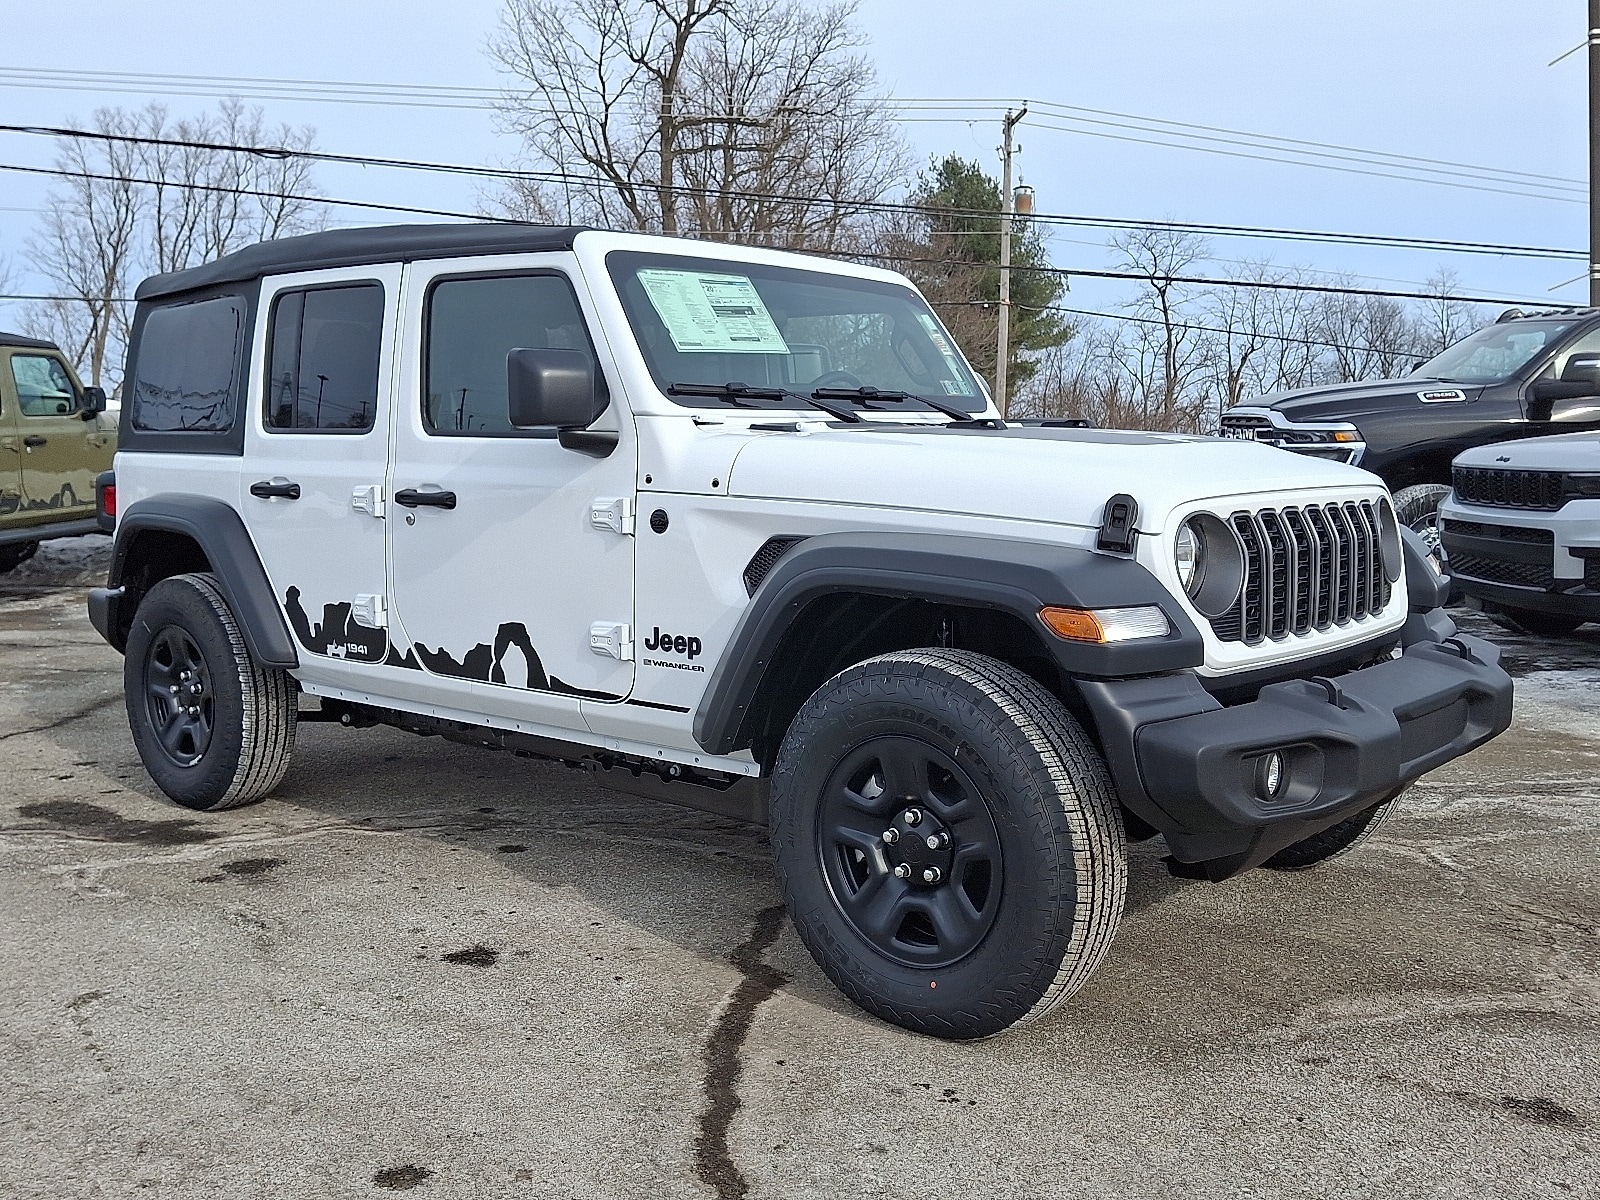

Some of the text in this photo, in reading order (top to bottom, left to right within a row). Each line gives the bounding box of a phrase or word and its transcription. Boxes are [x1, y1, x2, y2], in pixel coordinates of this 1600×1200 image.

[1225, 427, 1253, 440] RAM
[347, 643, 368, 655] 1941
[644, 626, 702, 660] Jeep
[652, 659, 705, 673] WRANGLER
